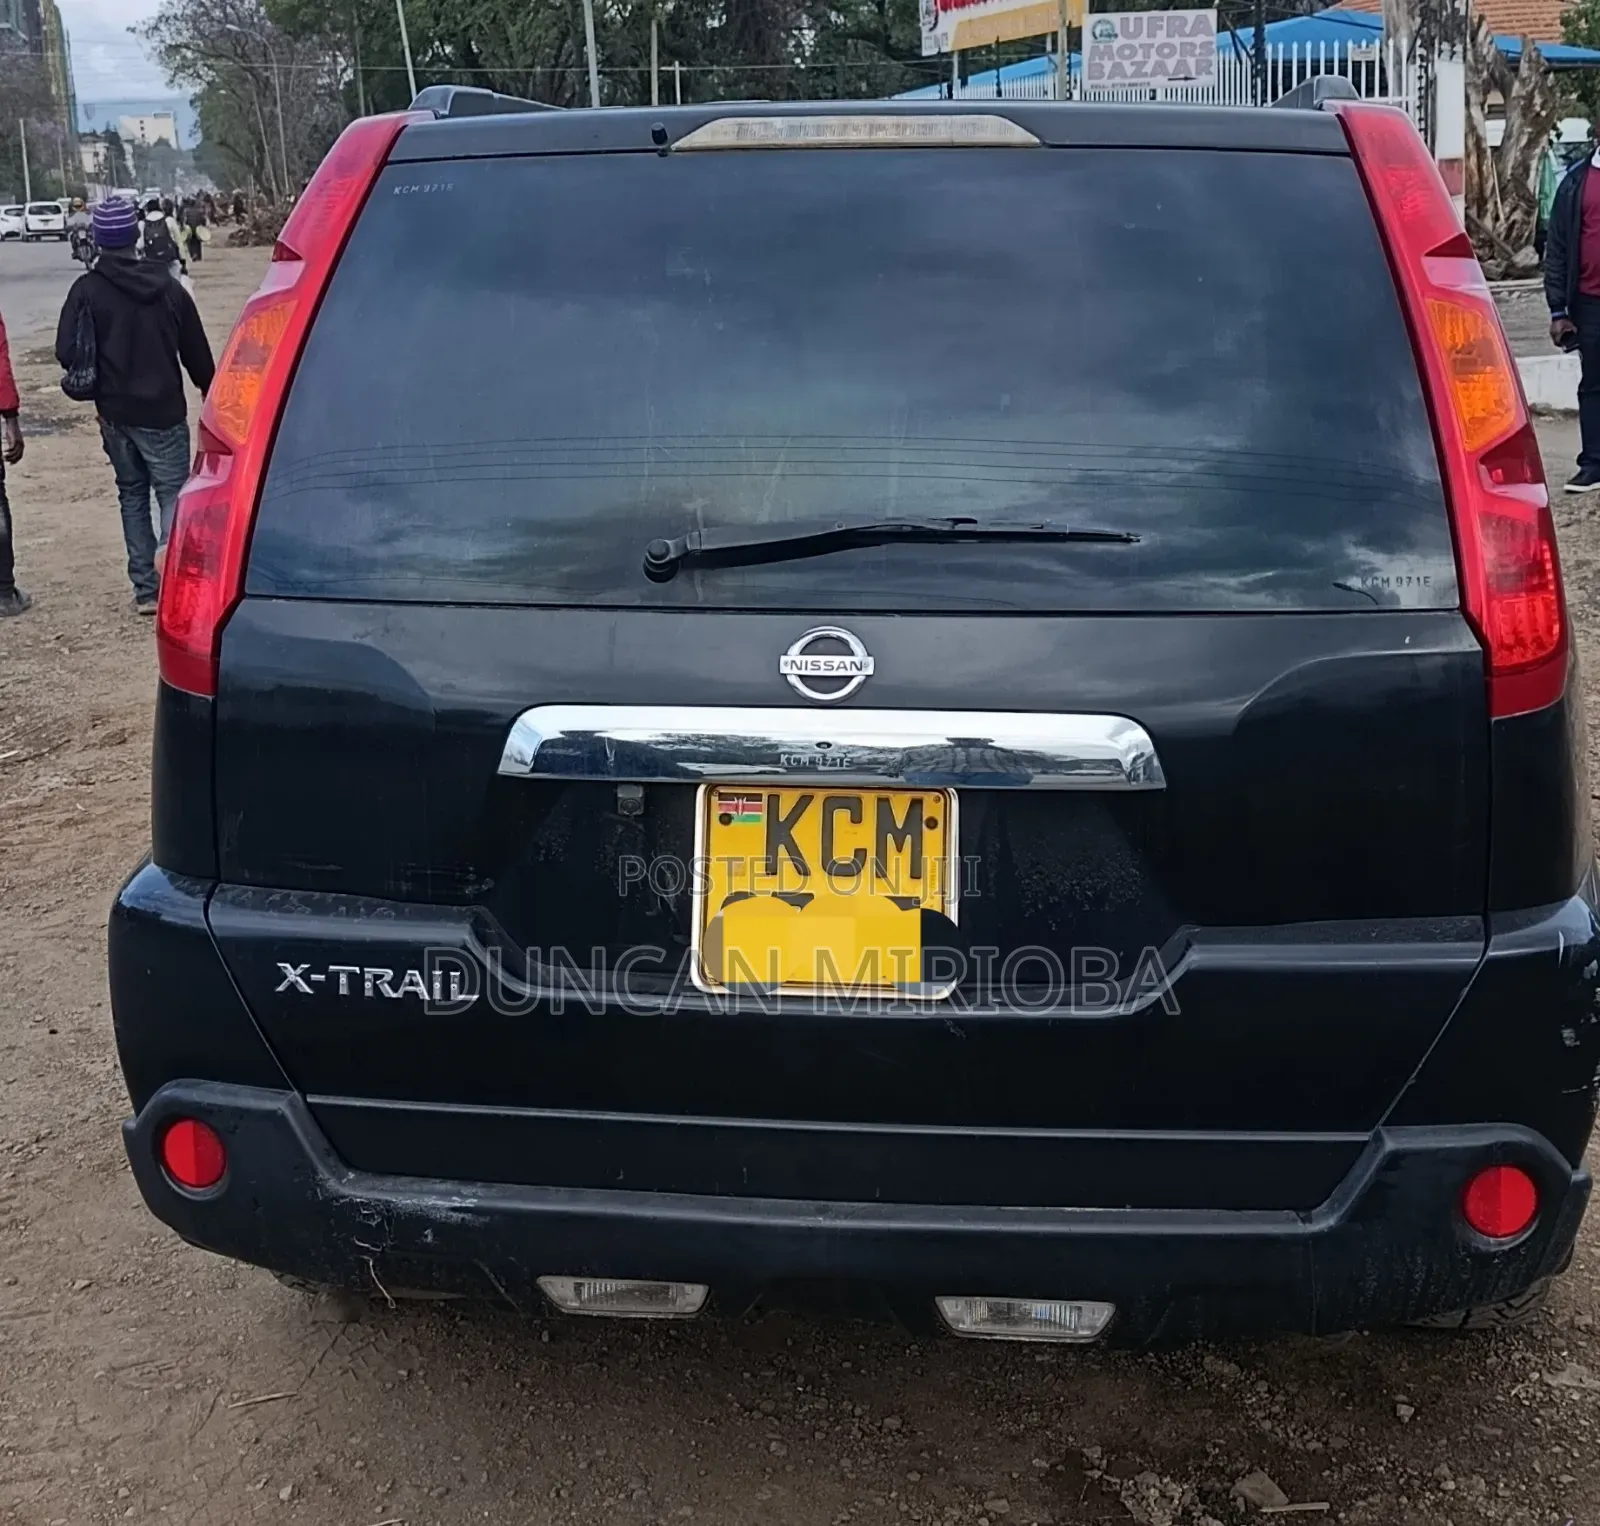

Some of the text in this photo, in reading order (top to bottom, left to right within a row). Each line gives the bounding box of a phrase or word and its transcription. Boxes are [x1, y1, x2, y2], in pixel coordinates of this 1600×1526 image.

[1119, 14, 1214, 40] UFRA
[1088, 41, 1215, 61] MOTORS
[1087, 58, 1213, 80] BAZAAR
[393, 184, 420, 195] KCM
[1360, 576, 1431, 588] KCM 971E
[790, 659, 863, 672] NISSAN
[780, 753, 810, 767] KCM
[765, 793, 924, 879] KCM
[276, 962, 480, 1001] X-TRAIL
